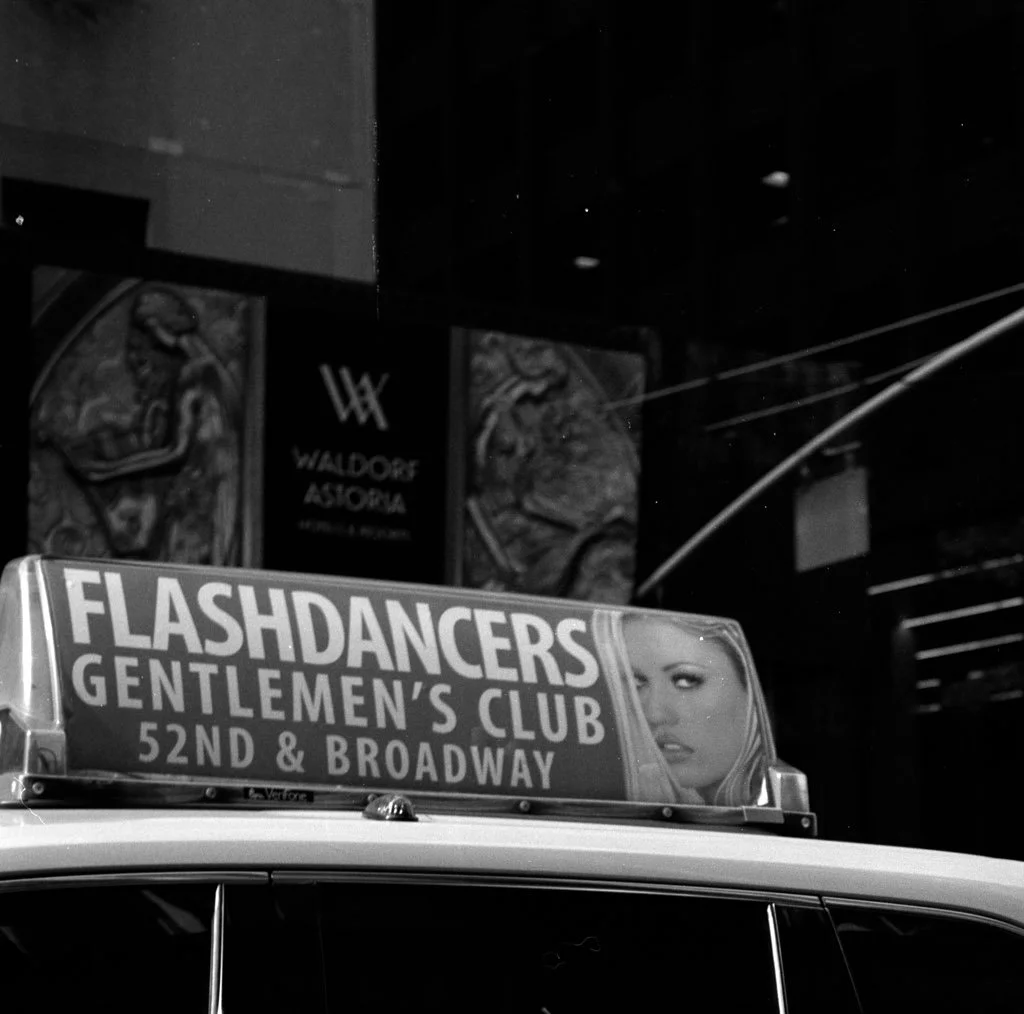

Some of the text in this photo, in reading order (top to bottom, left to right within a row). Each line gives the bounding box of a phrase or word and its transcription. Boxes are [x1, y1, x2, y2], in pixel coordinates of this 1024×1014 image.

[289, 444, 421, 483] WALDORF
[303, 481, 408, 515] ASTORIA
[64, 568, 600, 688] FLASHDANCERS
[72, 653, 605, 745] GENTLEMEN'S CLUB
[138, 721, 555, 789] 52ND & BROADWAY
